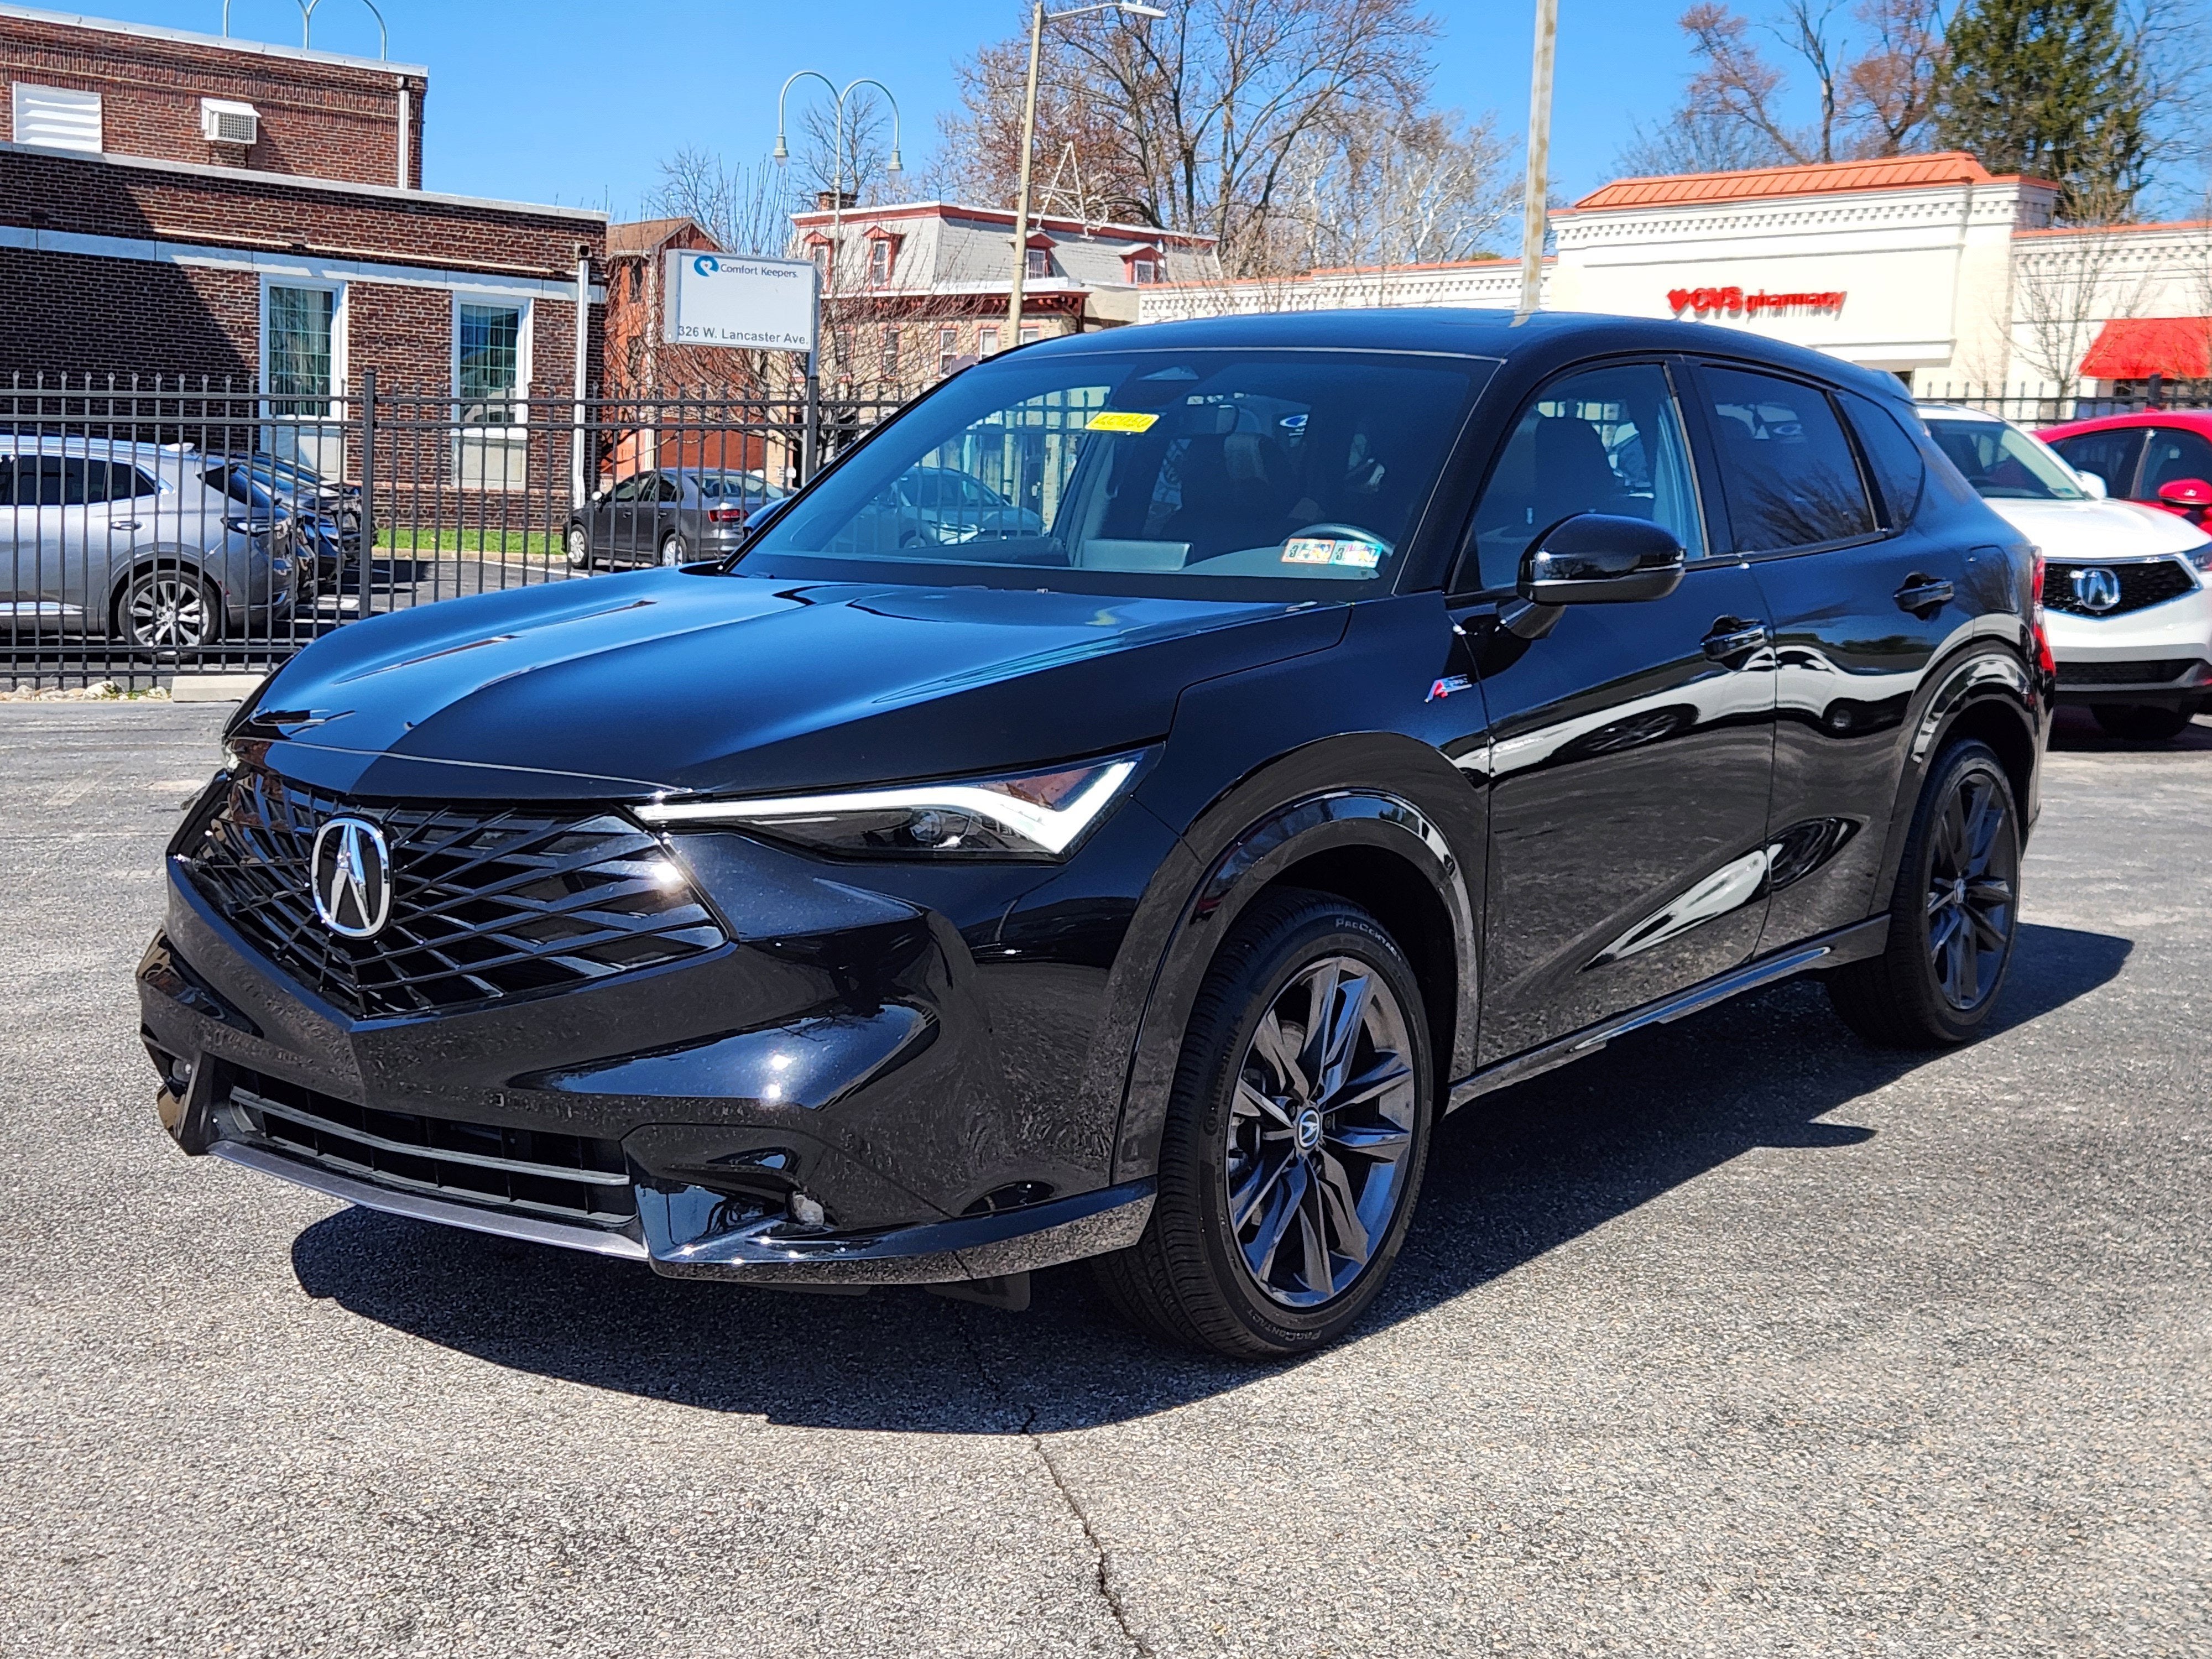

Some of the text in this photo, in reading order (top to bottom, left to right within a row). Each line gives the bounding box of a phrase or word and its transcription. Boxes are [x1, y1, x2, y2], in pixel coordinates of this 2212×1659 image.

[720, 263, 758, 275] Comfort
[1689, 286, 1848, 317] CVS pharmacy
[678, 326, 809, 345] 326 W. Lancaster Ave.
